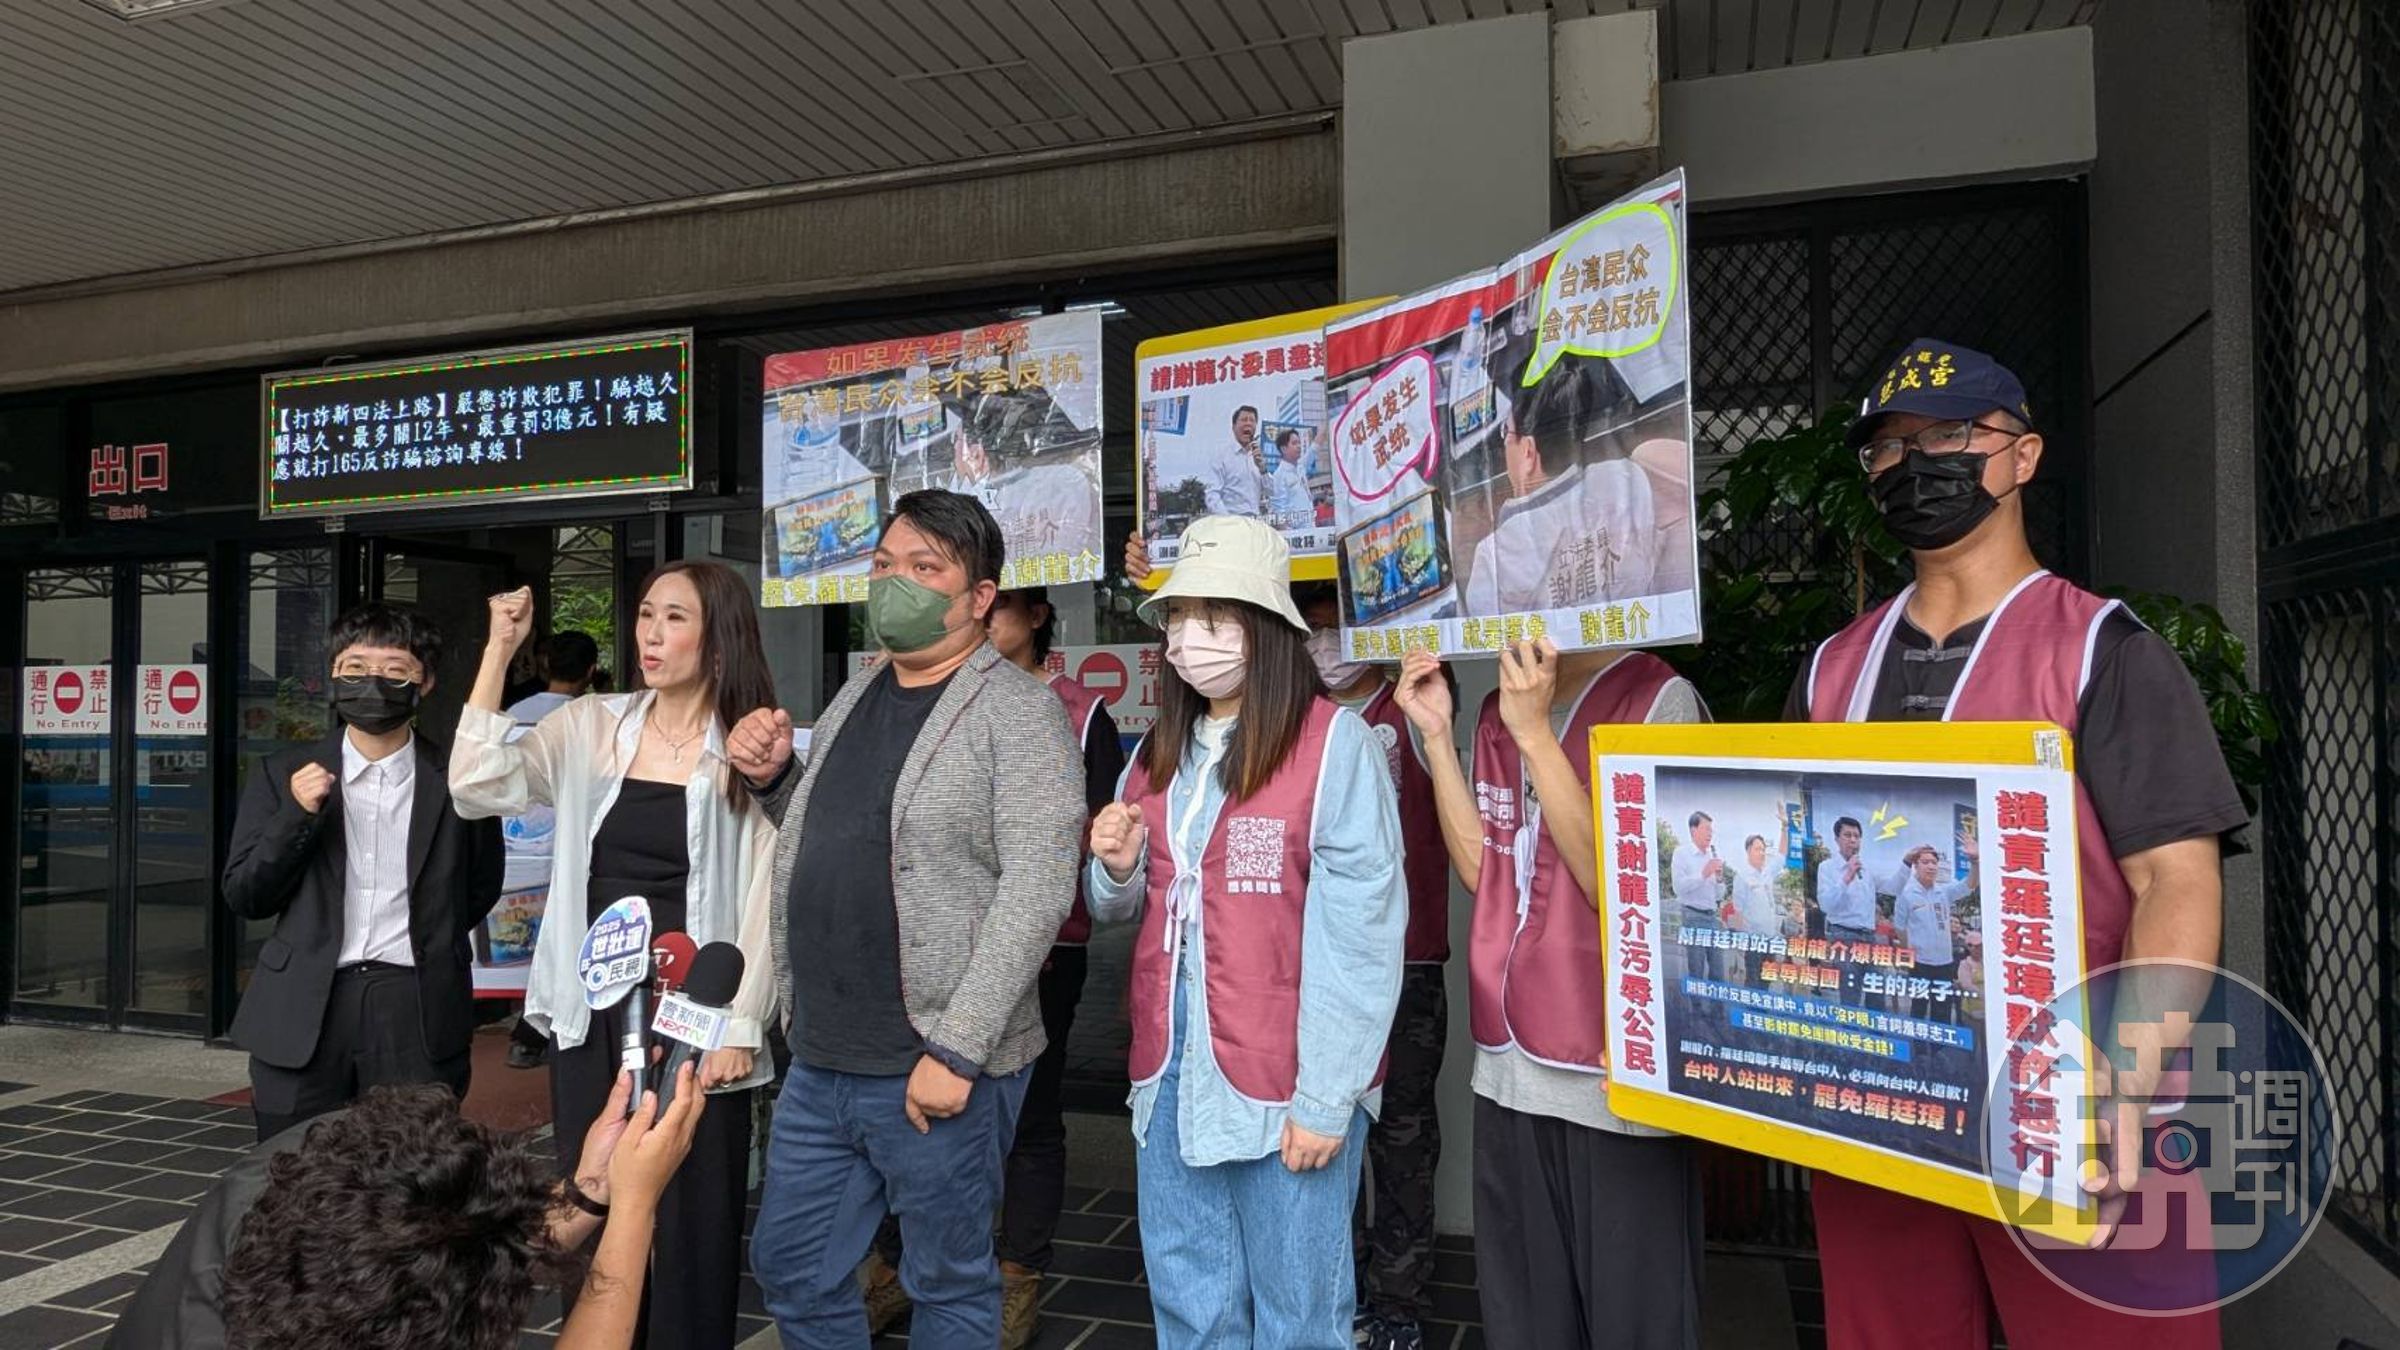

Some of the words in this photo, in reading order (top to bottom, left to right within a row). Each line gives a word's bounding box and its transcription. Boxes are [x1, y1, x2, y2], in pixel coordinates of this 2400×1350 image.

[1542, 286, 1660, 343] 会不会反抗
[90, 443, 168, 497] 出口
[109, 504, 147, 520] Exit
[1549, 549, 1621, 608] 謝龍介
[1580, 600, 1649, 646] 謝龍介
[31, 670, 48, 715] 通行
[90, 669, 108, 714] 禁止
[144, 669, 162, 715] 通行
[36, 719, 55, 729] No
[61, 719, 100, 730] Entry
[150, 719, 170, 729] No
[1114, 716, 1156, 729] try
[1611, 772, 1657, 1076] 譴責謝龍介污辱公民
[610, 957, 641, 981] 民視
[660, 999, 712, 1032] 壹新聞
